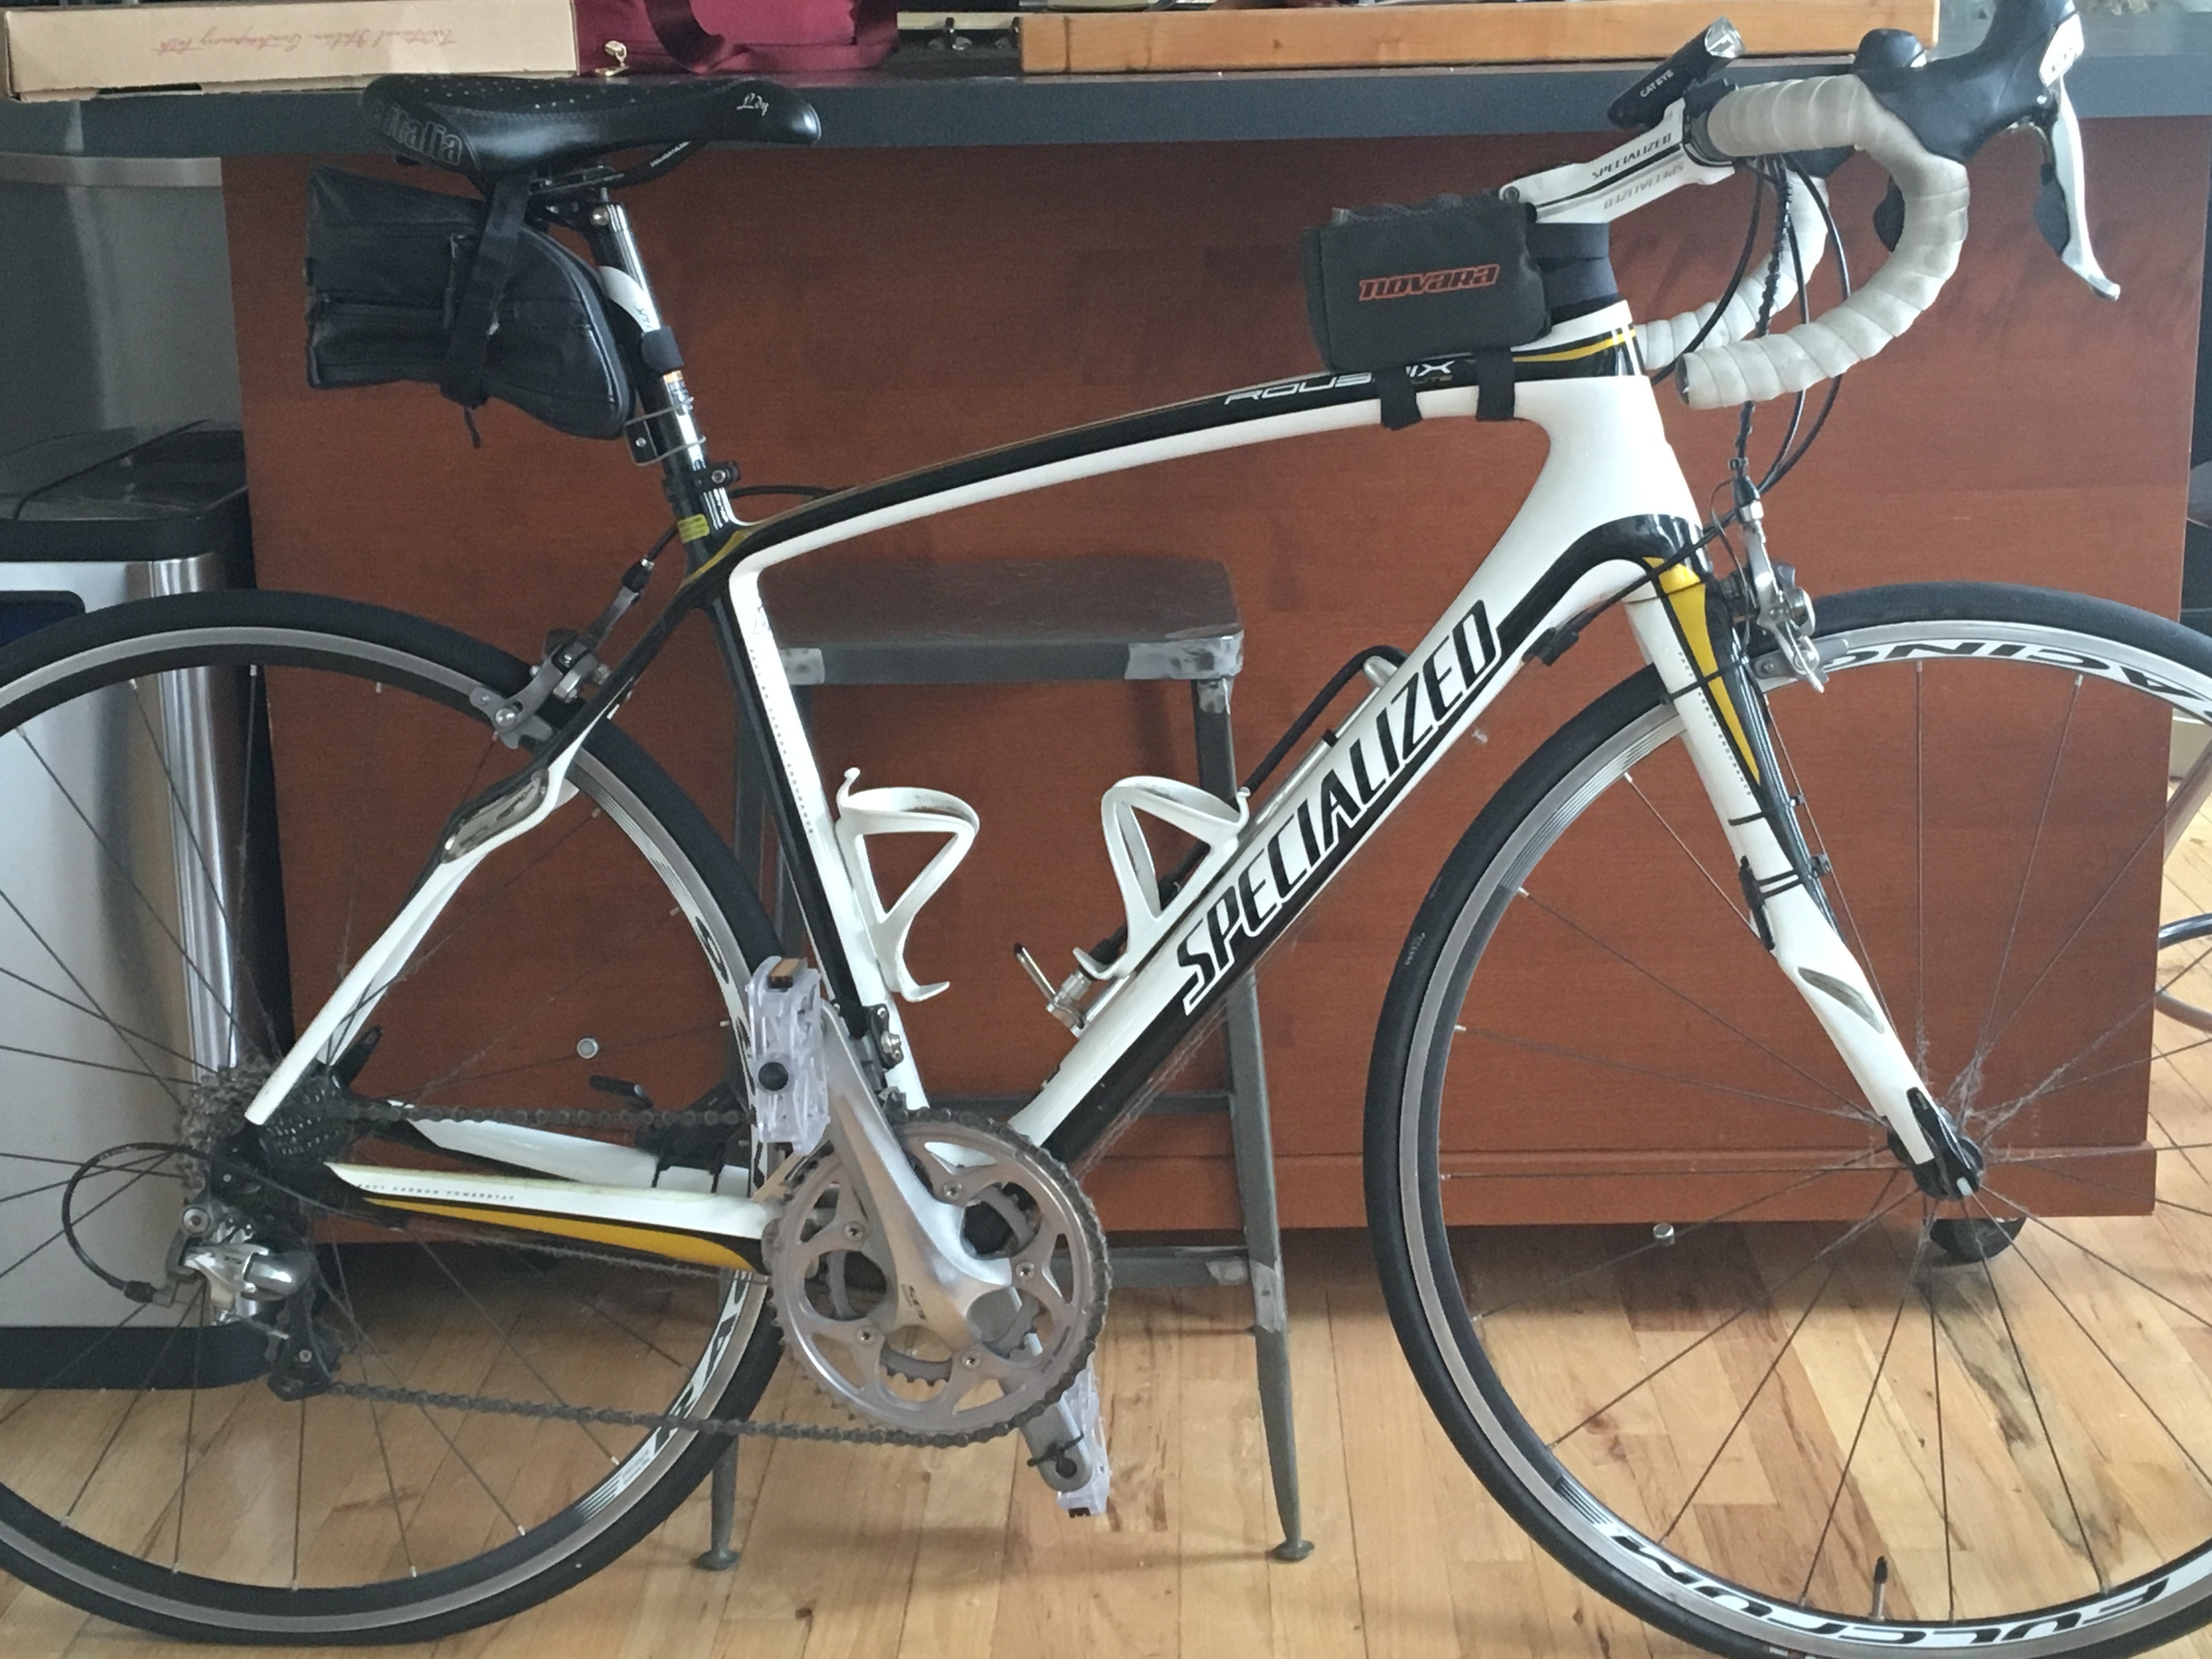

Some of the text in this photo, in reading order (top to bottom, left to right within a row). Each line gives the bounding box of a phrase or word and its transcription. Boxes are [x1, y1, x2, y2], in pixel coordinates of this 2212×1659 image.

[1640, 69, 1674, 98] CATEYE
[383, 103, 462, 166] italia
[1592, 132, 1672, 179] SPECIALIZED
[1223, 360, 1455, 404] ROUBIX
[1697, 691, 1718, 727] ARBON
[1176, 599, 1502, 1016] SPECIALIZED
